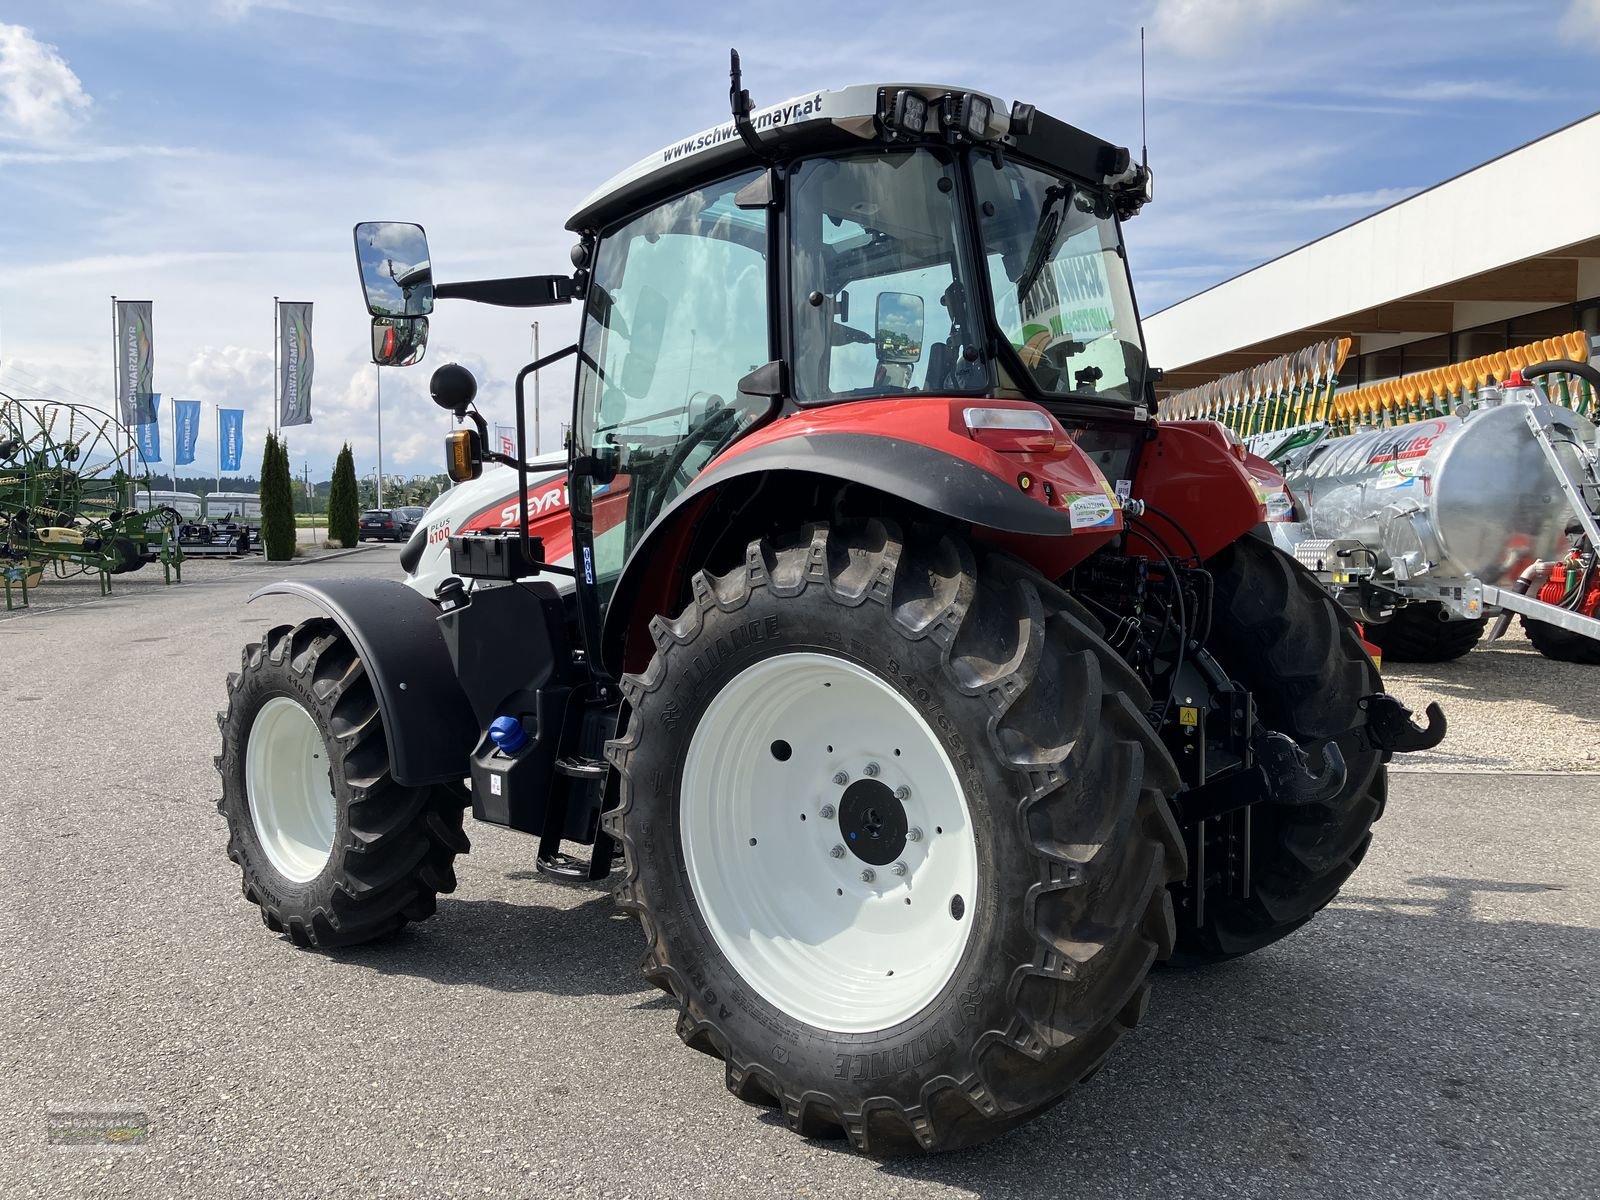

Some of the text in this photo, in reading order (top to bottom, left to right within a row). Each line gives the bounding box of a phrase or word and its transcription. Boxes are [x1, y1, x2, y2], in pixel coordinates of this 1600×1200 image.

[663, 94, 822, 162] www.schwazmayr.at
[128, 326, 138, 410] SCHWARZMAYR
[288, 326, 298, 411] SCHWARZMAYR
[429, 527, 450, 545] 4100
[430, 517, 451, 532] PLUS
[832, 992, 967, 1081] ALLIANCE
